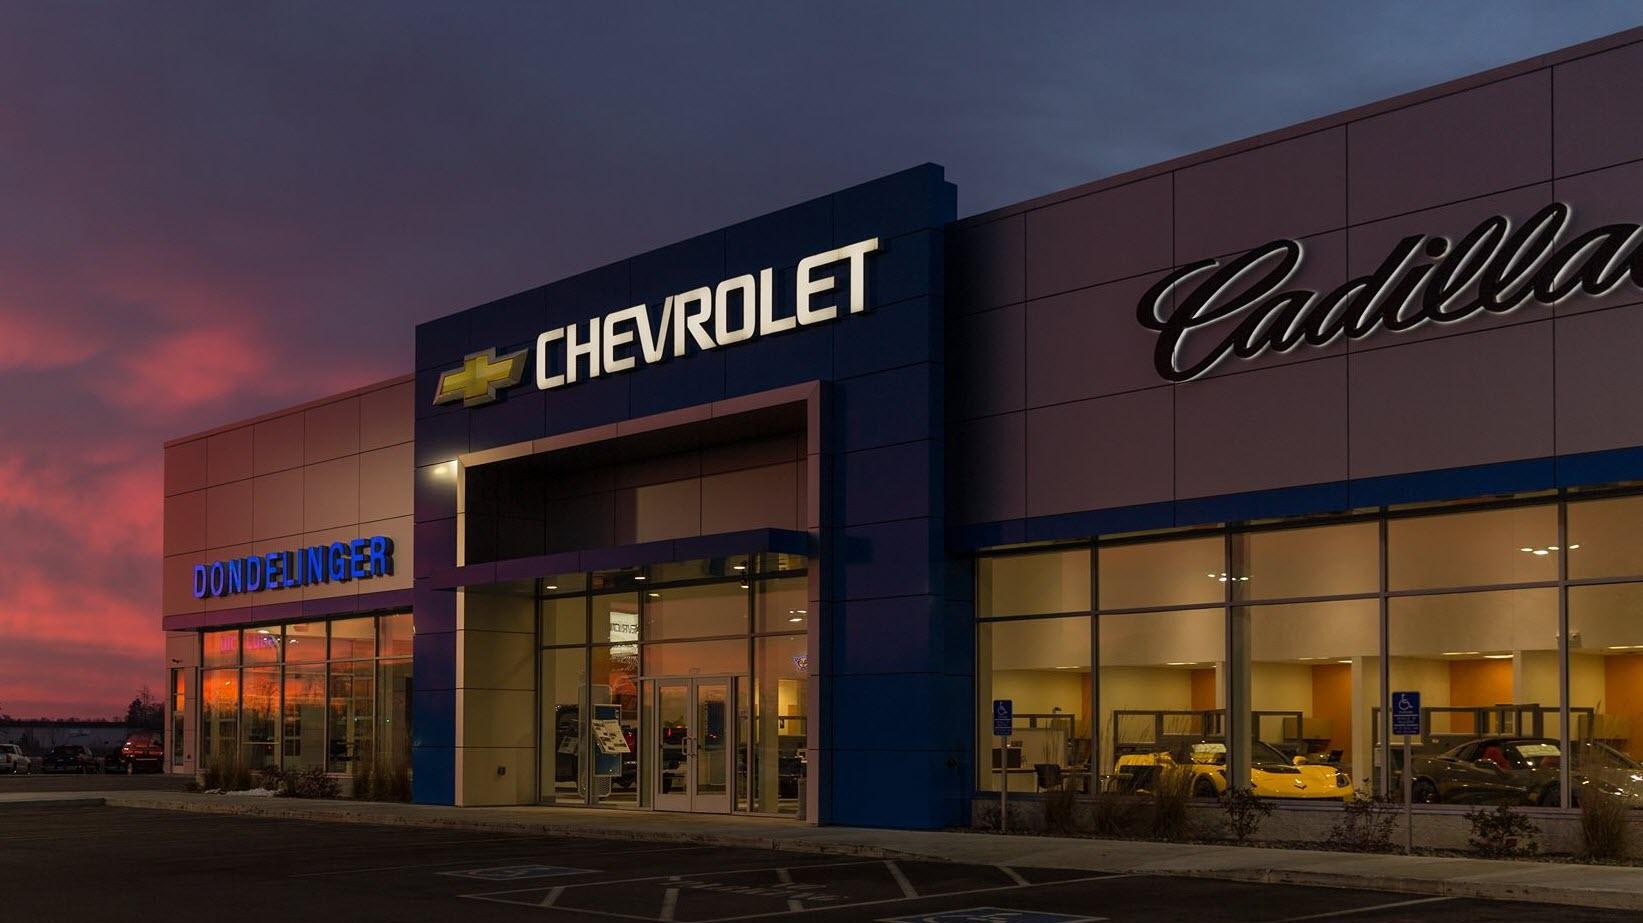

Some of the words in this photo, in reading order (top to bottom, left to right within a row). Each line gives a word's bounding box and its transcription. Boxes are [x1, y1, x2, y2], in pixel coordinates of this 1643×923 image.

[536, 237, 879, 390] CHEVROLET
[1136, 202, 1643, 381] Cadilla
[193, 535, 393, 599] DONDELINGER
